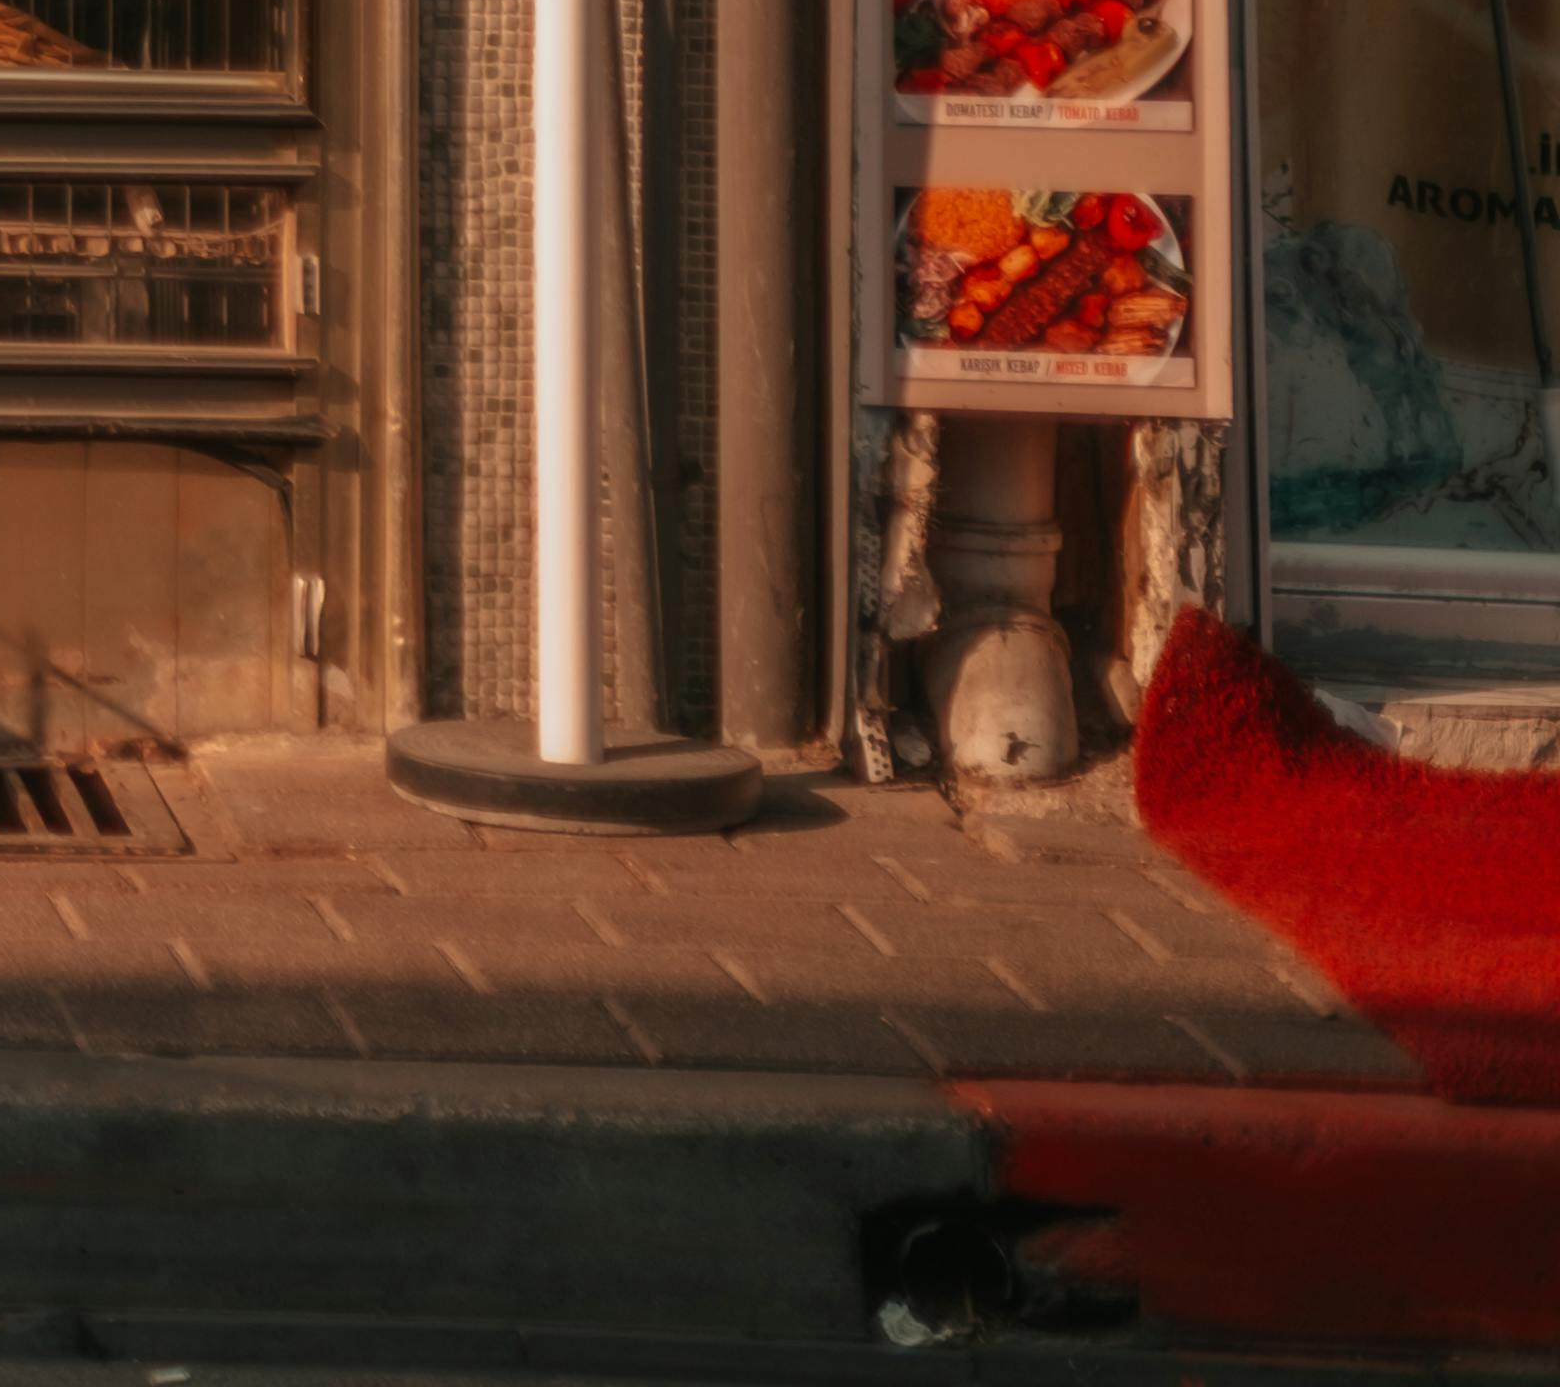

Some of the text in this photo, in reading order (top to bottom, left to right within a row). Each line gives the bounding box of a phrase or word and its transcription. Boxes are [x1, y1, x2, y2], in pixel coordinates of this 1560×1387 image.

[1010, 105, 1043, 119] KEBAP
[1058, 107, 1099, 121] TOMATO
[1007, 360, 1040, 374] KEBAP
